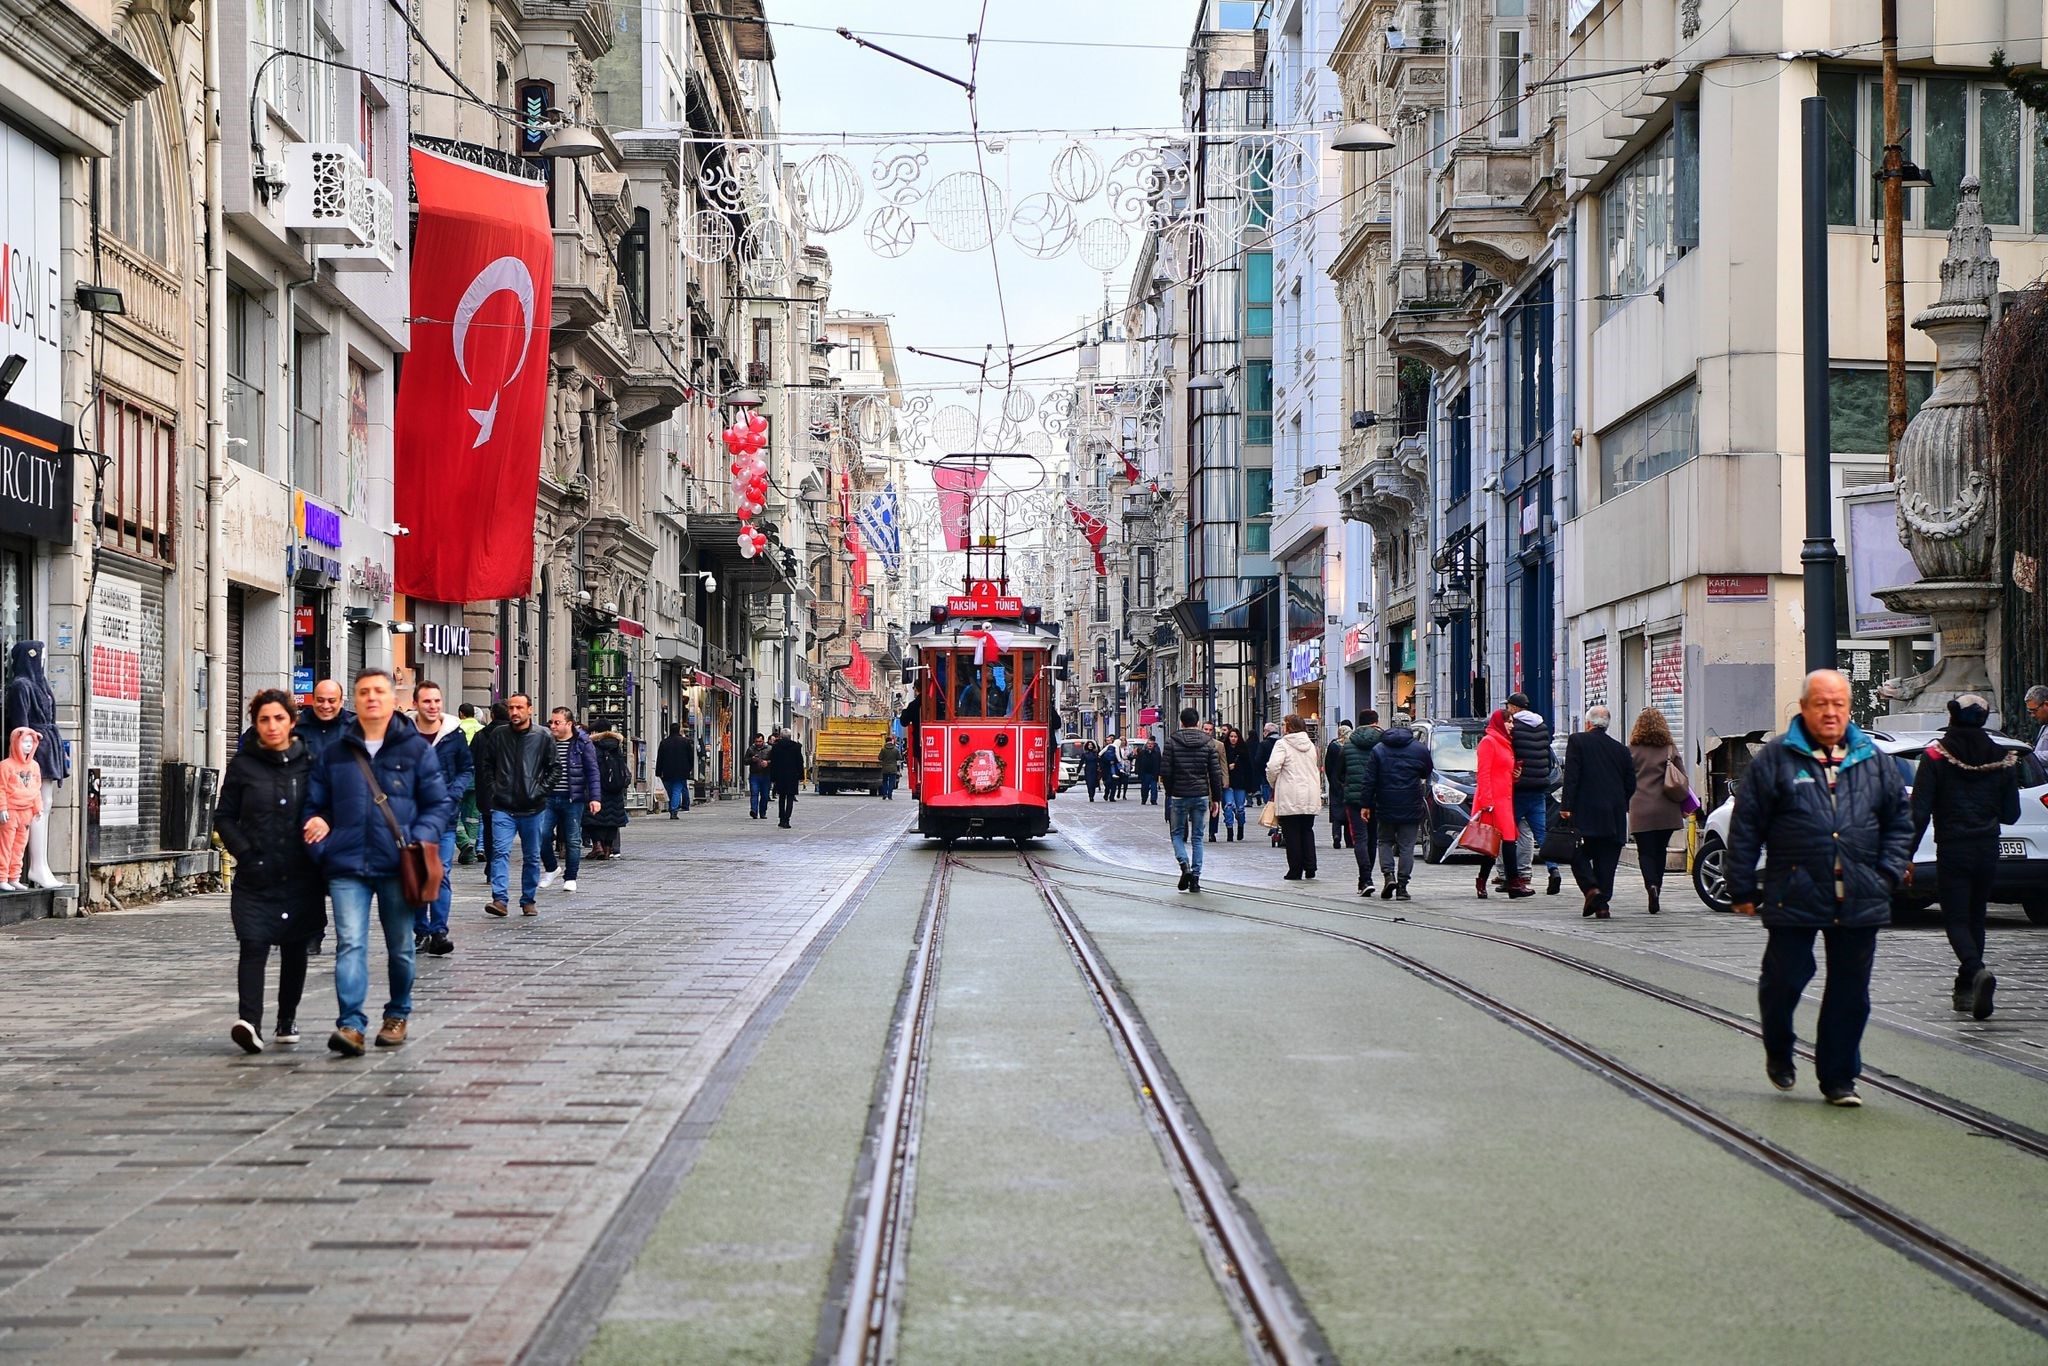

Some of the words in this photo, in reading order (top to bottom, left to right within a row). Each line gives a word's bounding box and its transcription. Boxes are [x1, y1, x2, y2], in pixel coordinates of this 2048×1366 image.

[12, 248, 57, 347] SALE
[0, 445, 57, 509] RCITY
[981, 583, 988, 596] 2
[1708, 579, 1740, 587] KARTAL
[949, 599, 978, 611] TAKSİM
[995, 598, 1019, 611] TÜNEL
[295, 608, 312, 617] AM
[423, 624, 470, 656] FLOWER
